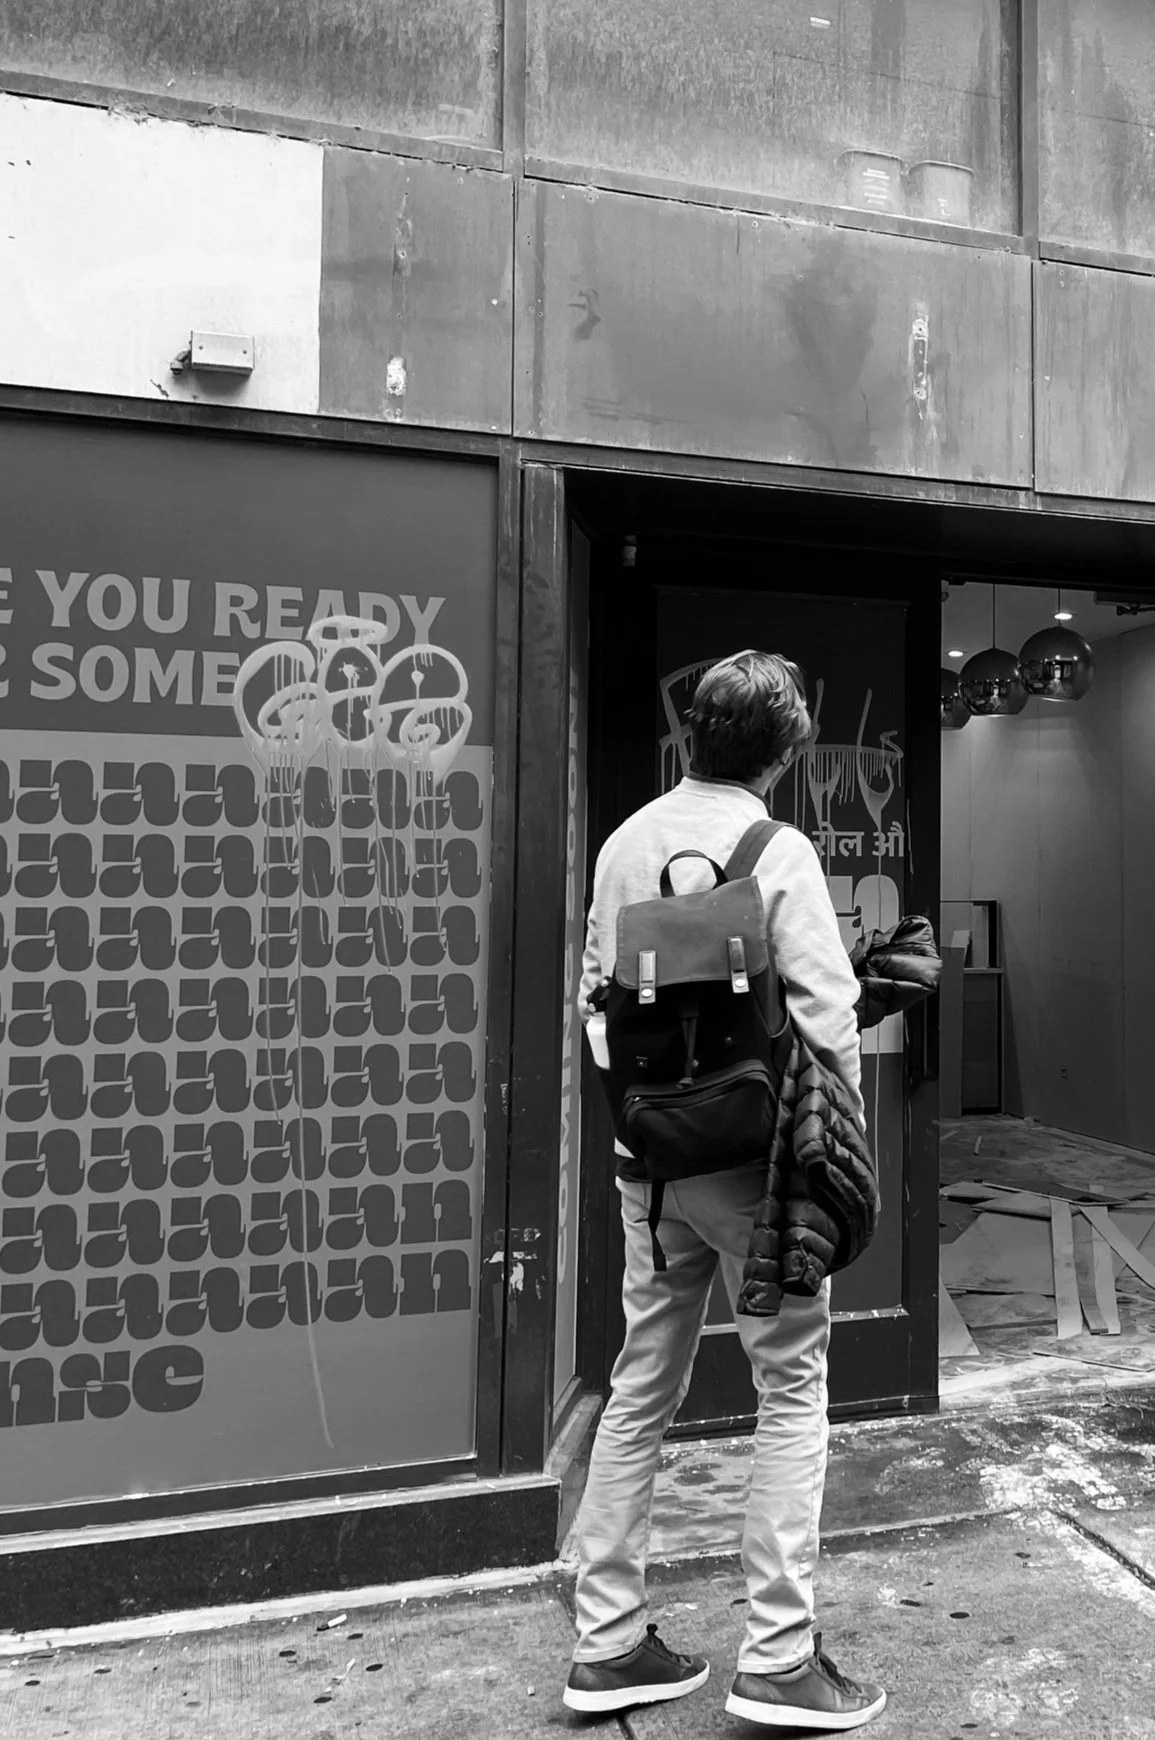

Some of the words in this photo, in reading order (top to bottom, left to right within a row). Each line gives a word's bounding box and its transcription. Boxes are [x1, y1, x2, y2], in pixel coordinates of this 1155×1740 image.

[35, 568, 191, 635] YOU
[213, 581, 446, 646] READY
[30, 641, 242, 707] SOME
